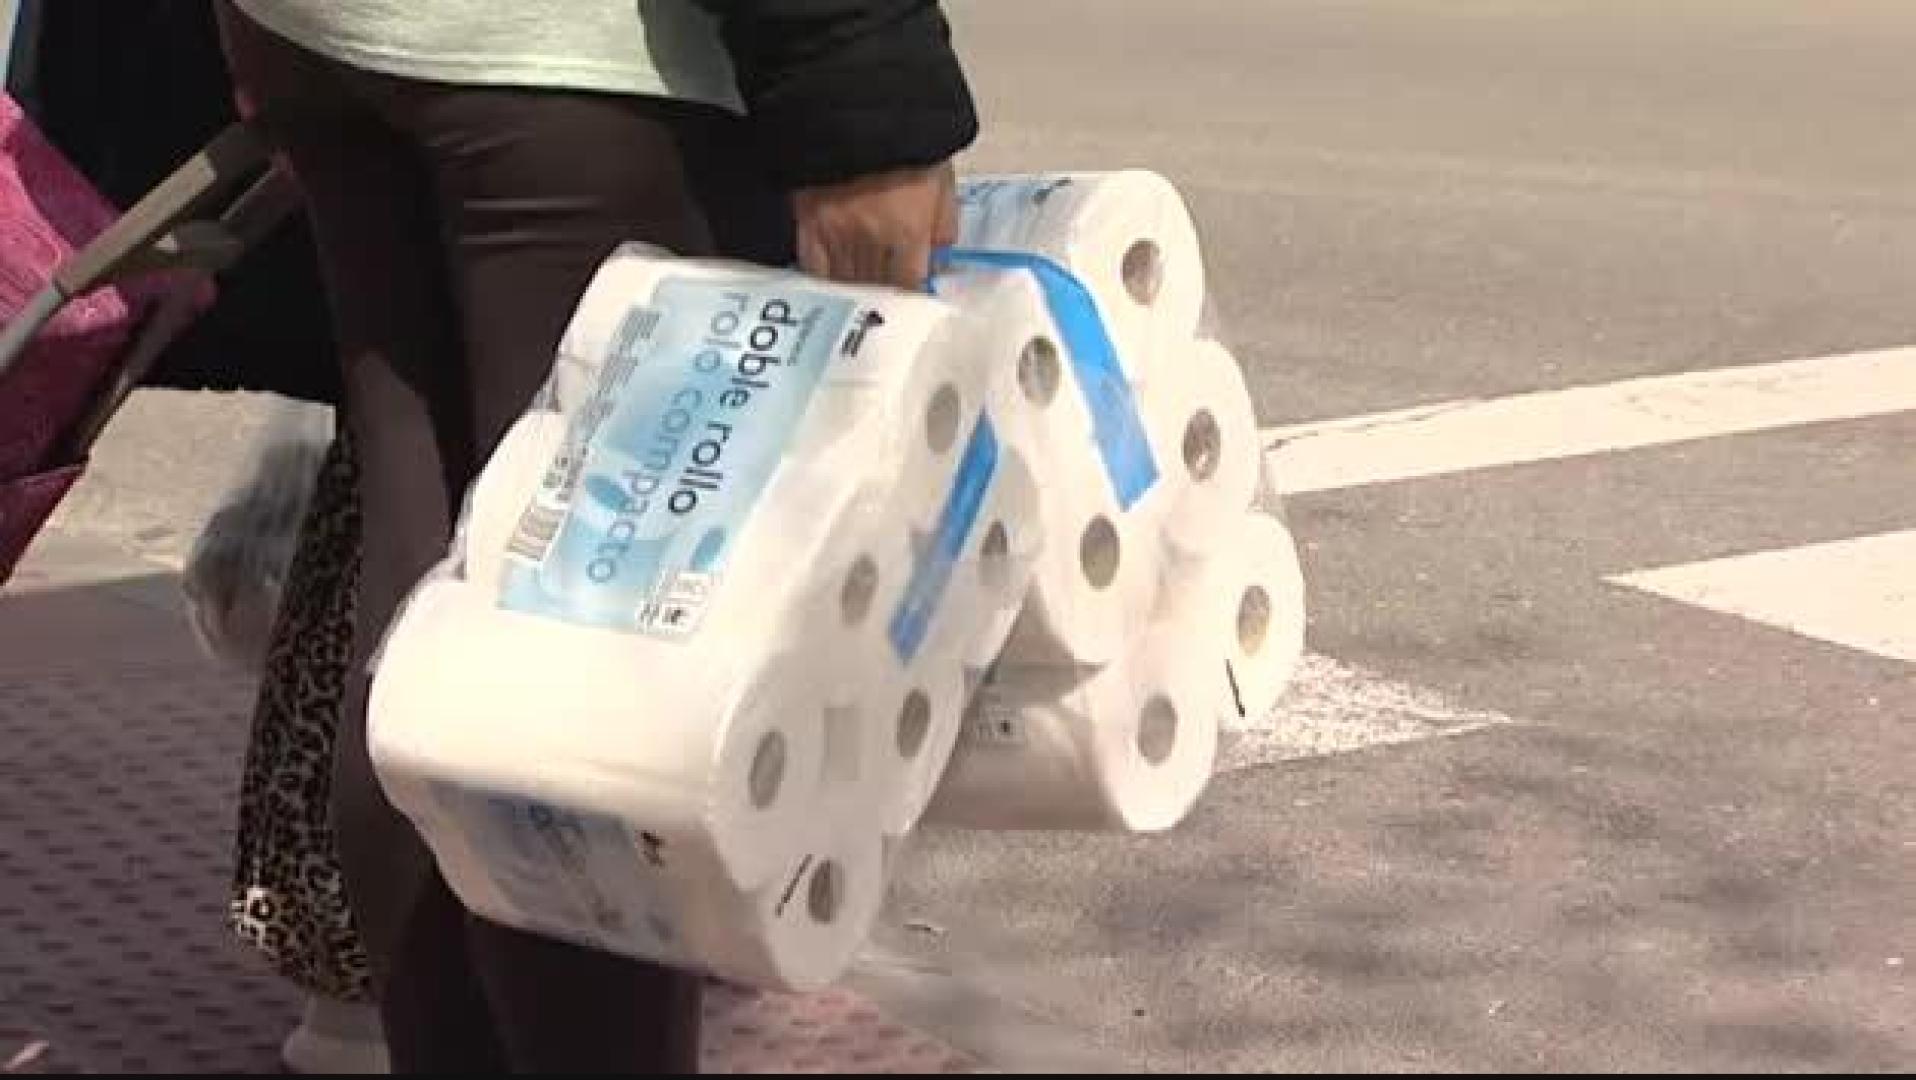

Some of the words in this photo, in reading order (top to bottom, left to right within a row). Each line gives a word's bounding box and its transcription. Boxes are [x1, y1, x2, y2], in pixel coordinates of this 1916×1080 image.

[693, 292, 749, 373] rolo
[719, 299, 798, 407] doble
[586, 389, 702, 583] compacto
[668, 421, 732, 514] rollo
